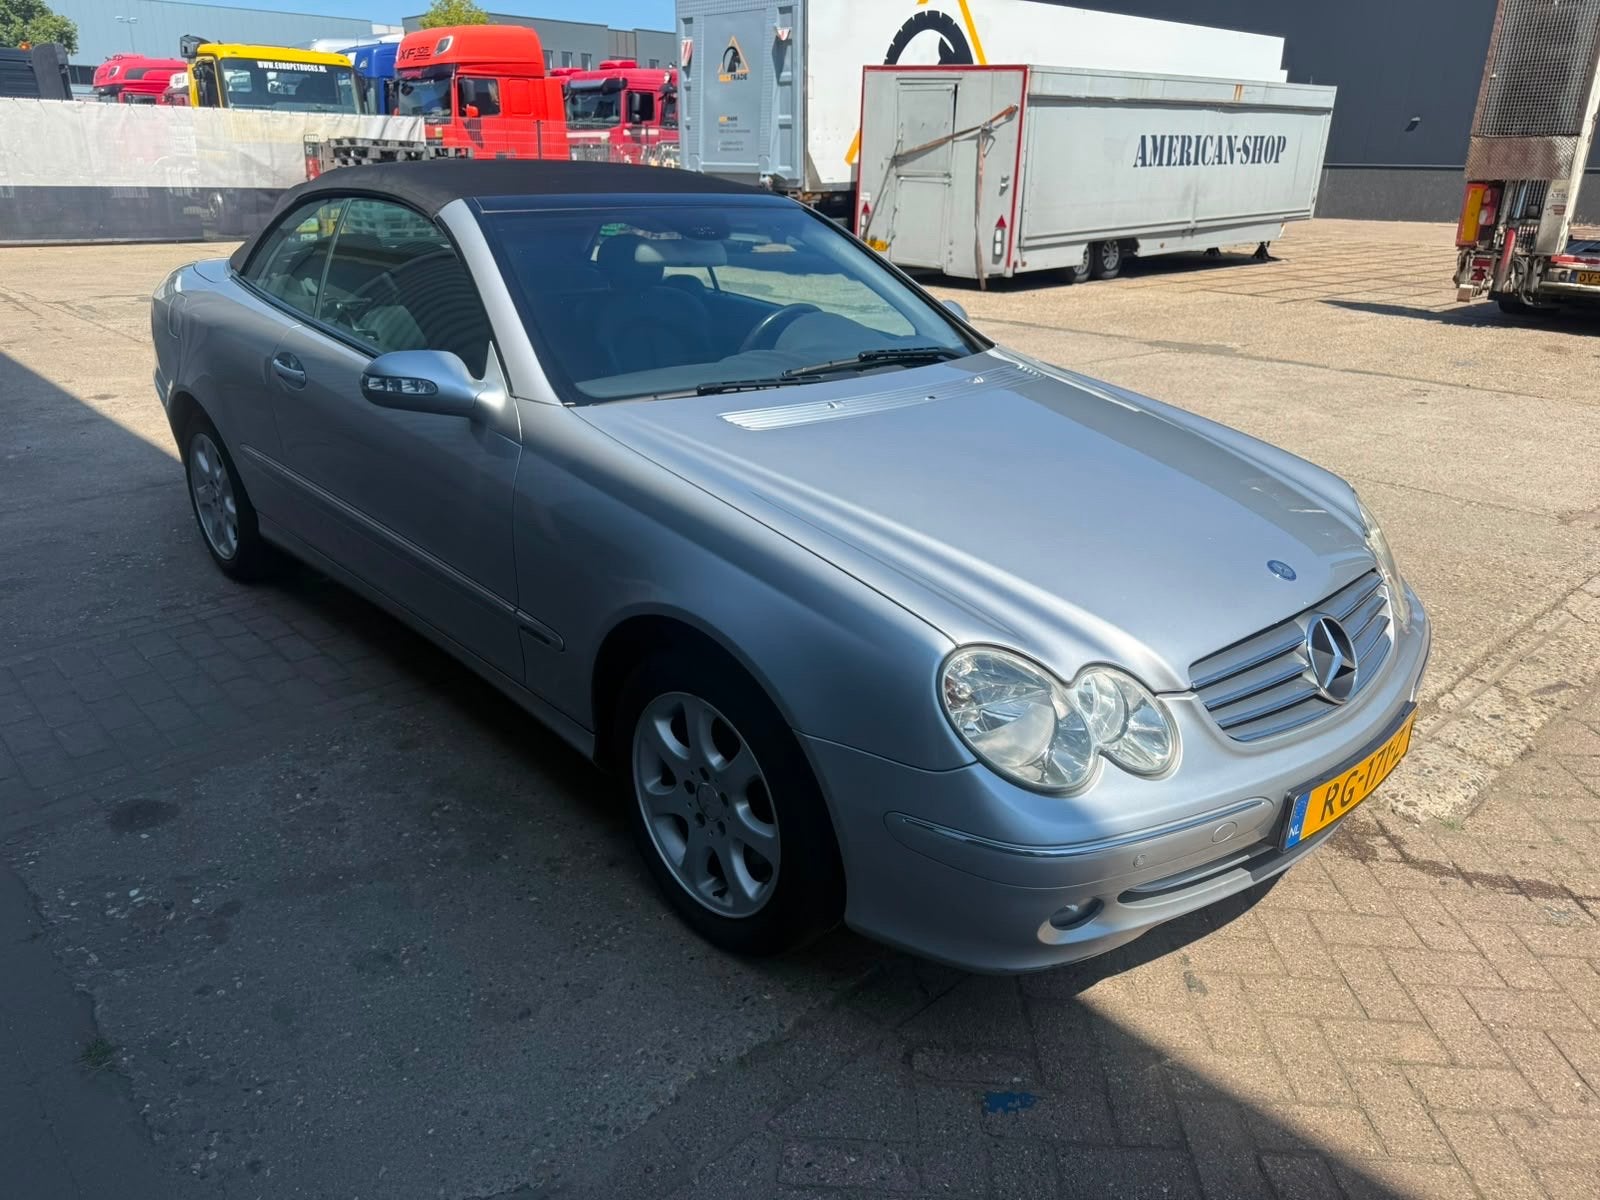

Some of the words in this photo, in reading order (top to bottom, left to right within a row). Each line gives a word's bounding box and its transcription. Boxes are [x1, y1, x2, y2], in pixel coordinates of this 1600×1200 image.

[399, 48, 415, 60] XF
[256, 60, 328, 73] WWW.EUROPETRUCKS.NL
[1133, 134, 1287, 168] AMERICAN-SHOP
[1319, 724, 1408, 823] RG-171-Z
[1288, 823, 1300, 839] NL
